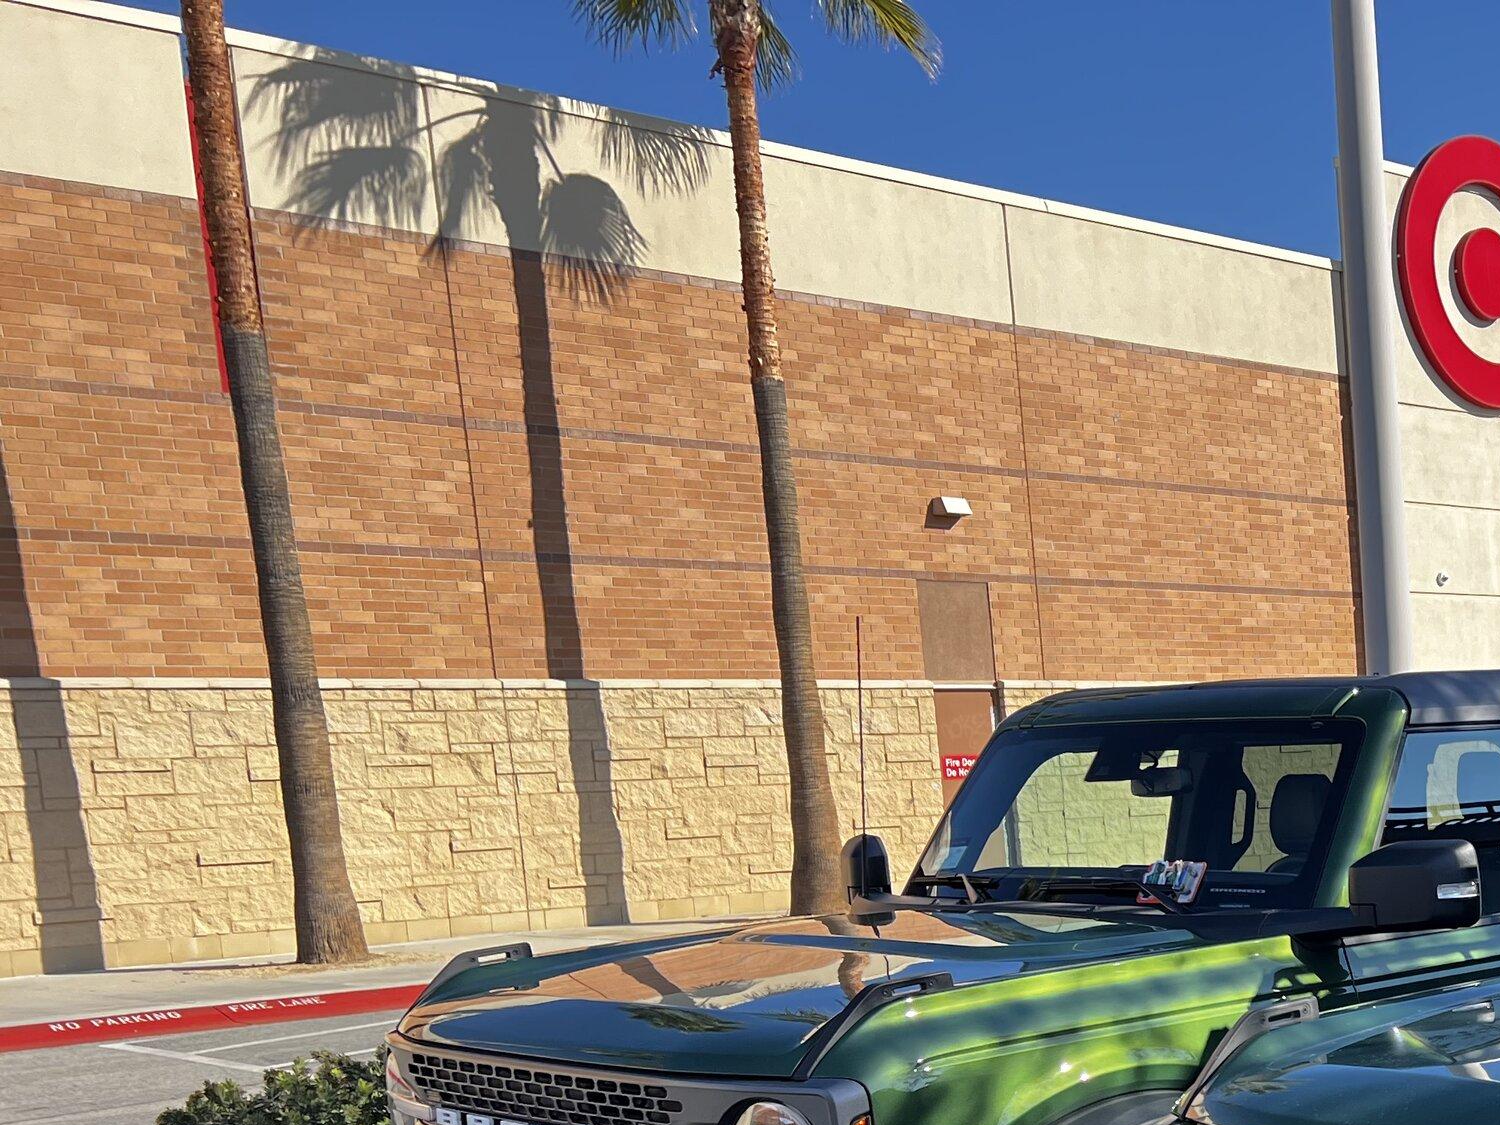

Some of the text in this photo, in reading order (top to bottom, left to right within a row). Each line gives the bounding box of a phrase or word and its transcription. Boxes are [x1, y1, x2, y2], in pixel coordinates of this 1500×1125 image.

[945, 758, 960, 767] Fire
[946, 768, 970, 777] Do No
[227, 996, 326, 1013] FIRE LANE
[49, 1010, 182, 1032] NO PARKING
